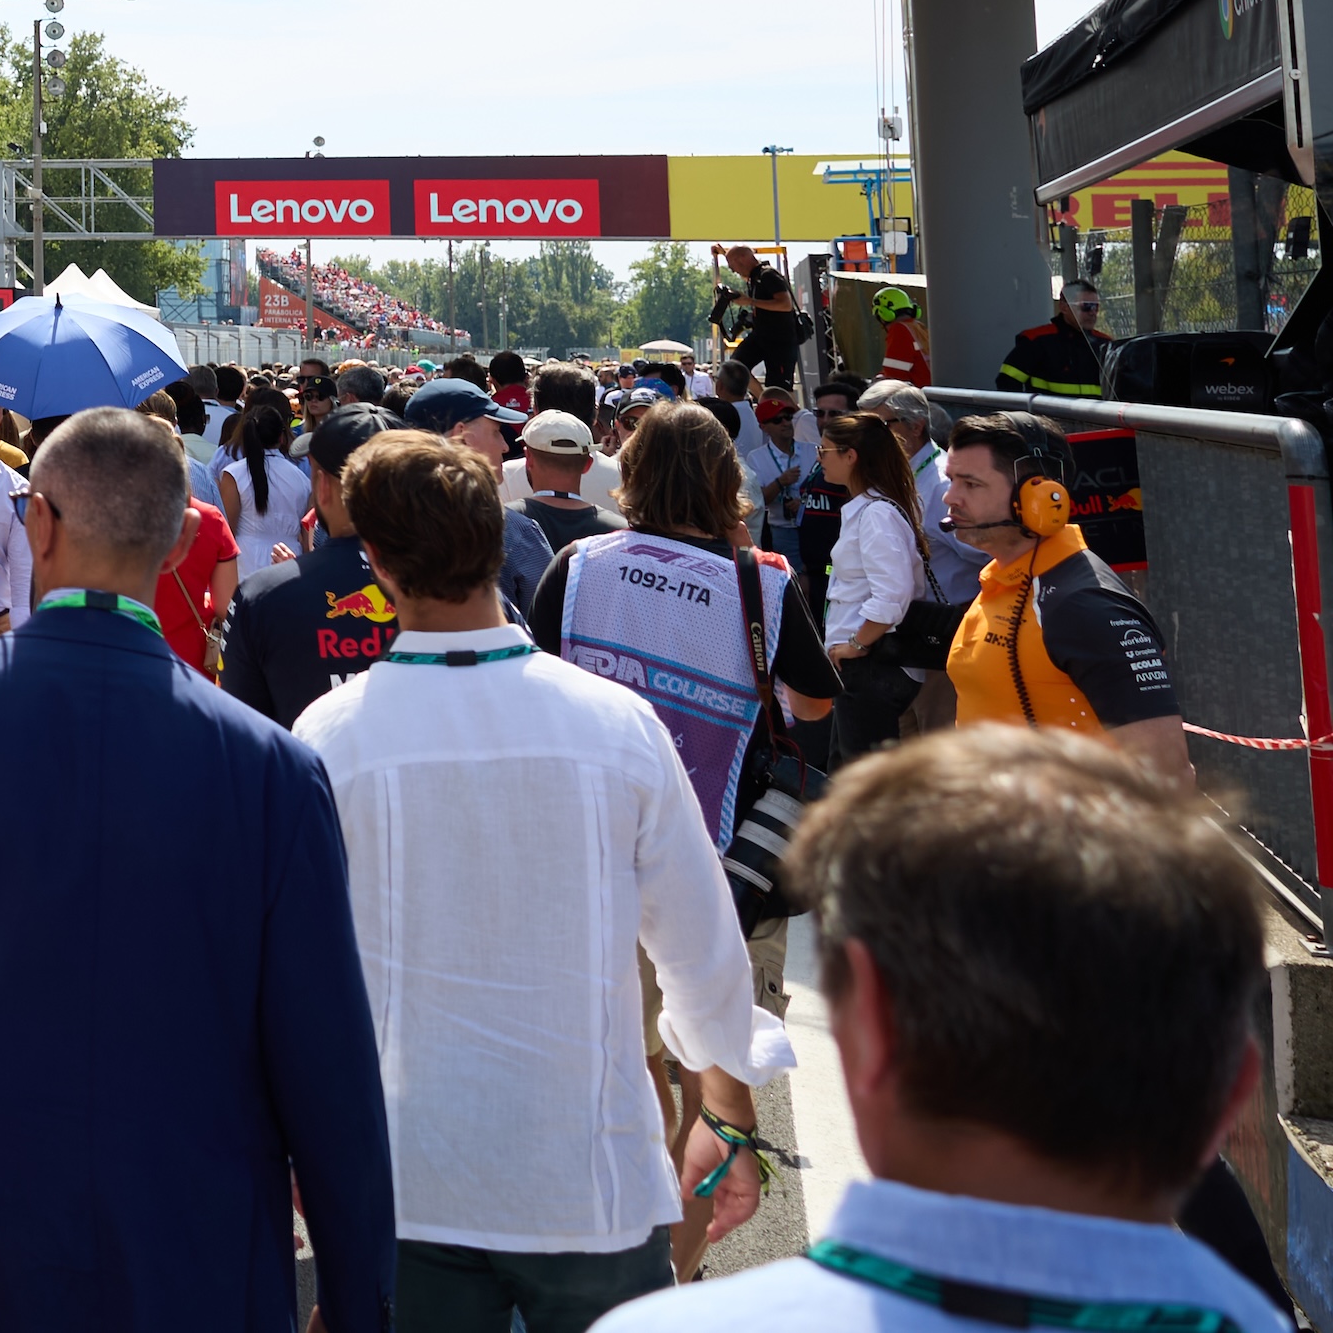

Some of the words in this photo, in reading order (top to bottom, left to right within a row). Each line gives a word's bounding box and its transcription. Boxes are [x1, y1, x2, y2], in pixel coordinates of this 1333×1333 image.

[229, 193, 375, 224] Lenovo
[429, 192, 583, 224] Lenovo
[264, 295, 290, 307] 23B
[264, 308, 303, 316] PARABOLICA
[131, 365, 161, 387] AMERICAN
[138, 371, 165, 390] EXPRESS
[1204, 382, 1255, 395] webex
[806, 491, 830, 511] Bull
[619, 565, 711, 607] 1092-ITA
[316, 626, 382, 659] Red
[750, 621, 766, 672] Canon
[1119, 636, 1151, 647] workday
[1129, 659, 1163, 671] ECOLAB
[652, 671, 747, 717] COURSE
